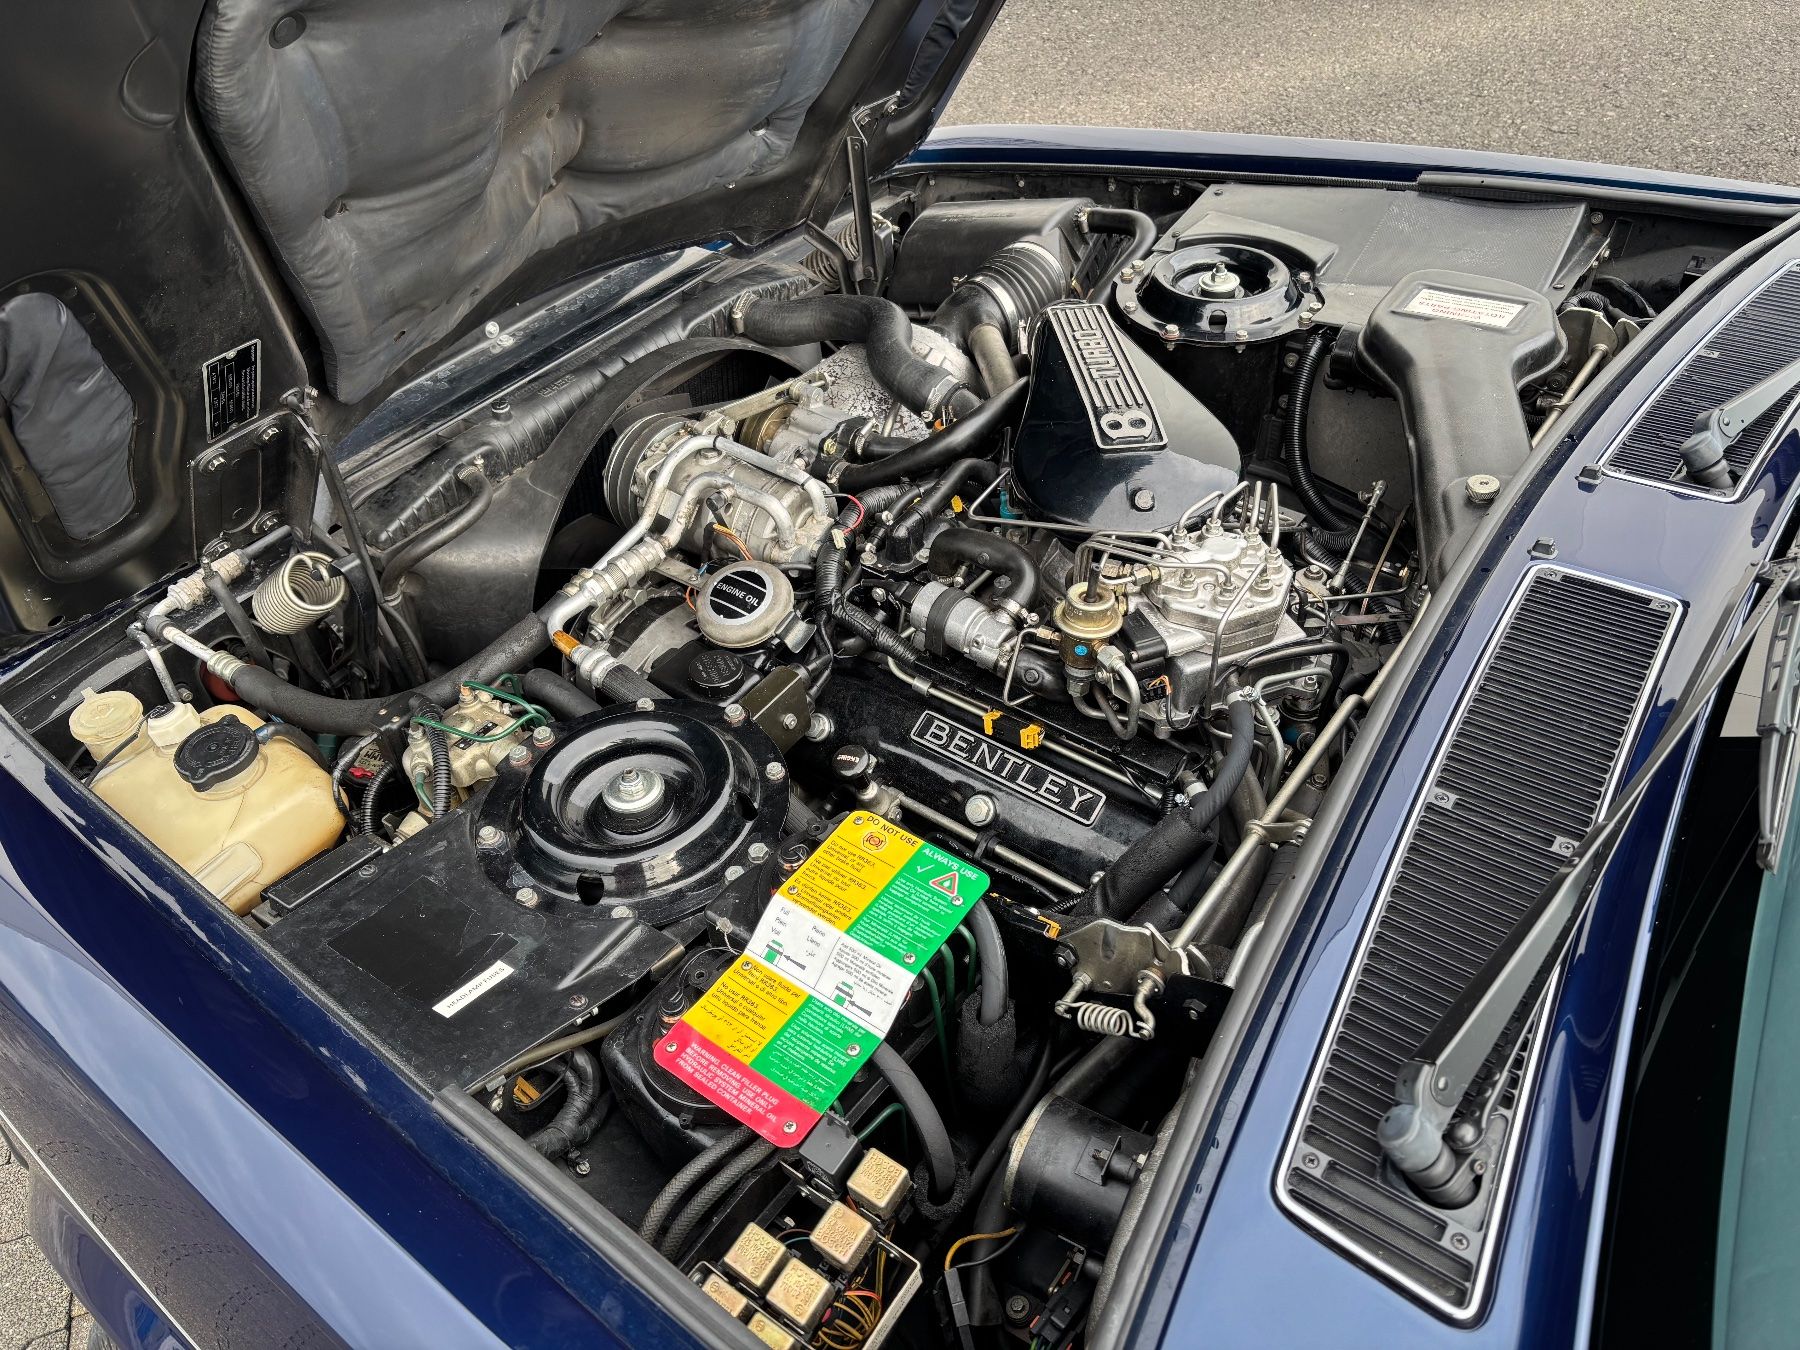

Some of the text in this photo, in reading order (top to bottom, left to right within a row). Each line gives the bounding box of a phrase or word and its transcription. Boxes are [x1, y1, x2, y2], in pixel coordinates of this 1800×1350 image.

[1073, 327, 1121, 379] TURBO
[716, 582, 759, 606] ENGINE OIL
[923, 719, 1095, 809] BENTLEY
[865, 815, 919, 847] DO NOT USE
[920, 846, 960, 870] ALWAYS
[958, 866, 979, 880] USE
[673, 1057, 695, 1073] FROM
[692, 1070, 719, 1090] SEALED
[678, 1052, 779, 1123] HYDRAULIC SYSTEM MINERAL OIL
[683, 1047, 710, 1066] BEFORE
[741, 1086, 757, 1099] USE
[753, 1095, 774, 1111] ONLY
[719, 1062, 742, 1079] CLEAN
[739, 1076, 763, 1094] FILLER
[760, 1090, 780, 1106] PLUG
[868, 1152, 901, 1176] BOSCH
[814, 1230, 848, 1256] BOSCH
